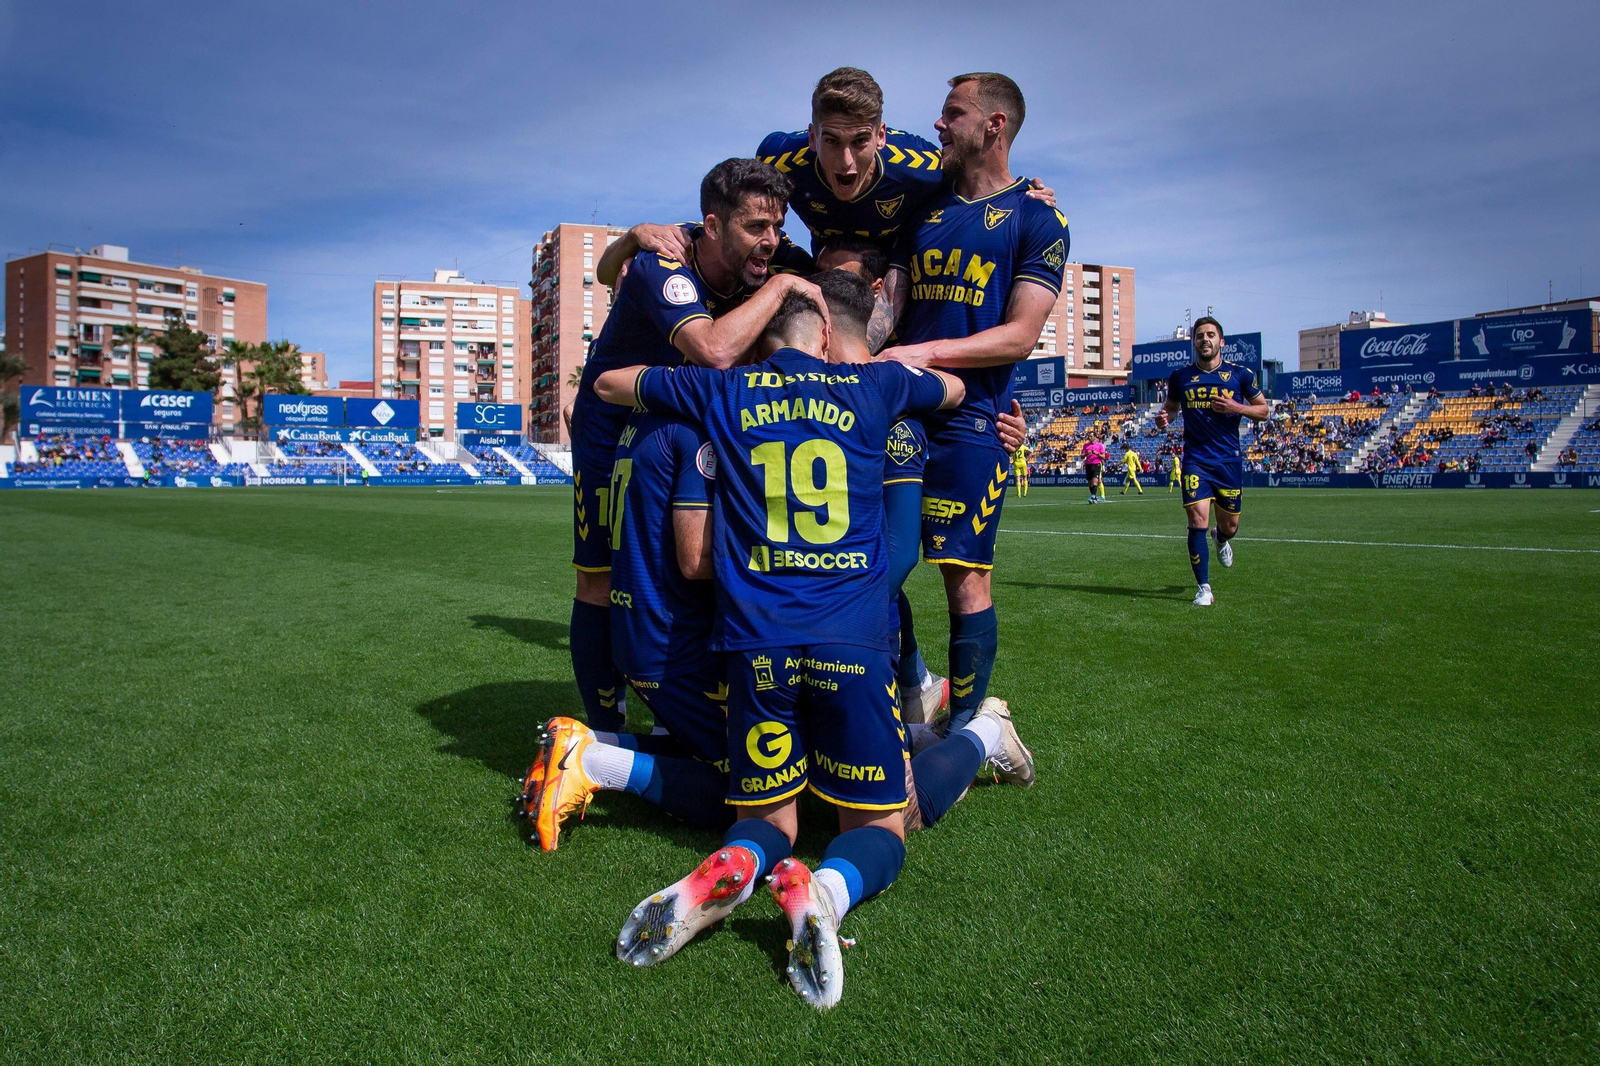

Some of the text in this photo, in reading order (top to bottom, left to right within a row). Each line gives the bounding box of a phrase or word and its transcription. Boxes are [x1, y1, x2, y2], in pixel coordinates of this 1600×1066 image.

[911, 249, 996, 289] UCAM
[1143, 350, 1190, 363] DISPROL
[1371, 373, 1422, 383] serunion
[56, 390, 111, 400] LUMEN
[148, 395, 193, 408] caser
[1066, 390, 1124, 403] Granate.es
[153, 410, 181, 418] seguros
[740, 398, 856, 432] ARMANDO
[291, 430, 342, 441] CaixaBank
[362, 431, 410, 441] CaixaBank
[480, 436, 506, 445] Aisla(+)
[887, 440, 914, 454] Niña
[1184, 474, 1199, 490] 18
[1381, 474, 1433, 486] ENERYETI
[751, 439, 850, 544] 19
[774, 550, 868, 569] BESOCCER
[814, 749, 886, 782] VIVENTA
